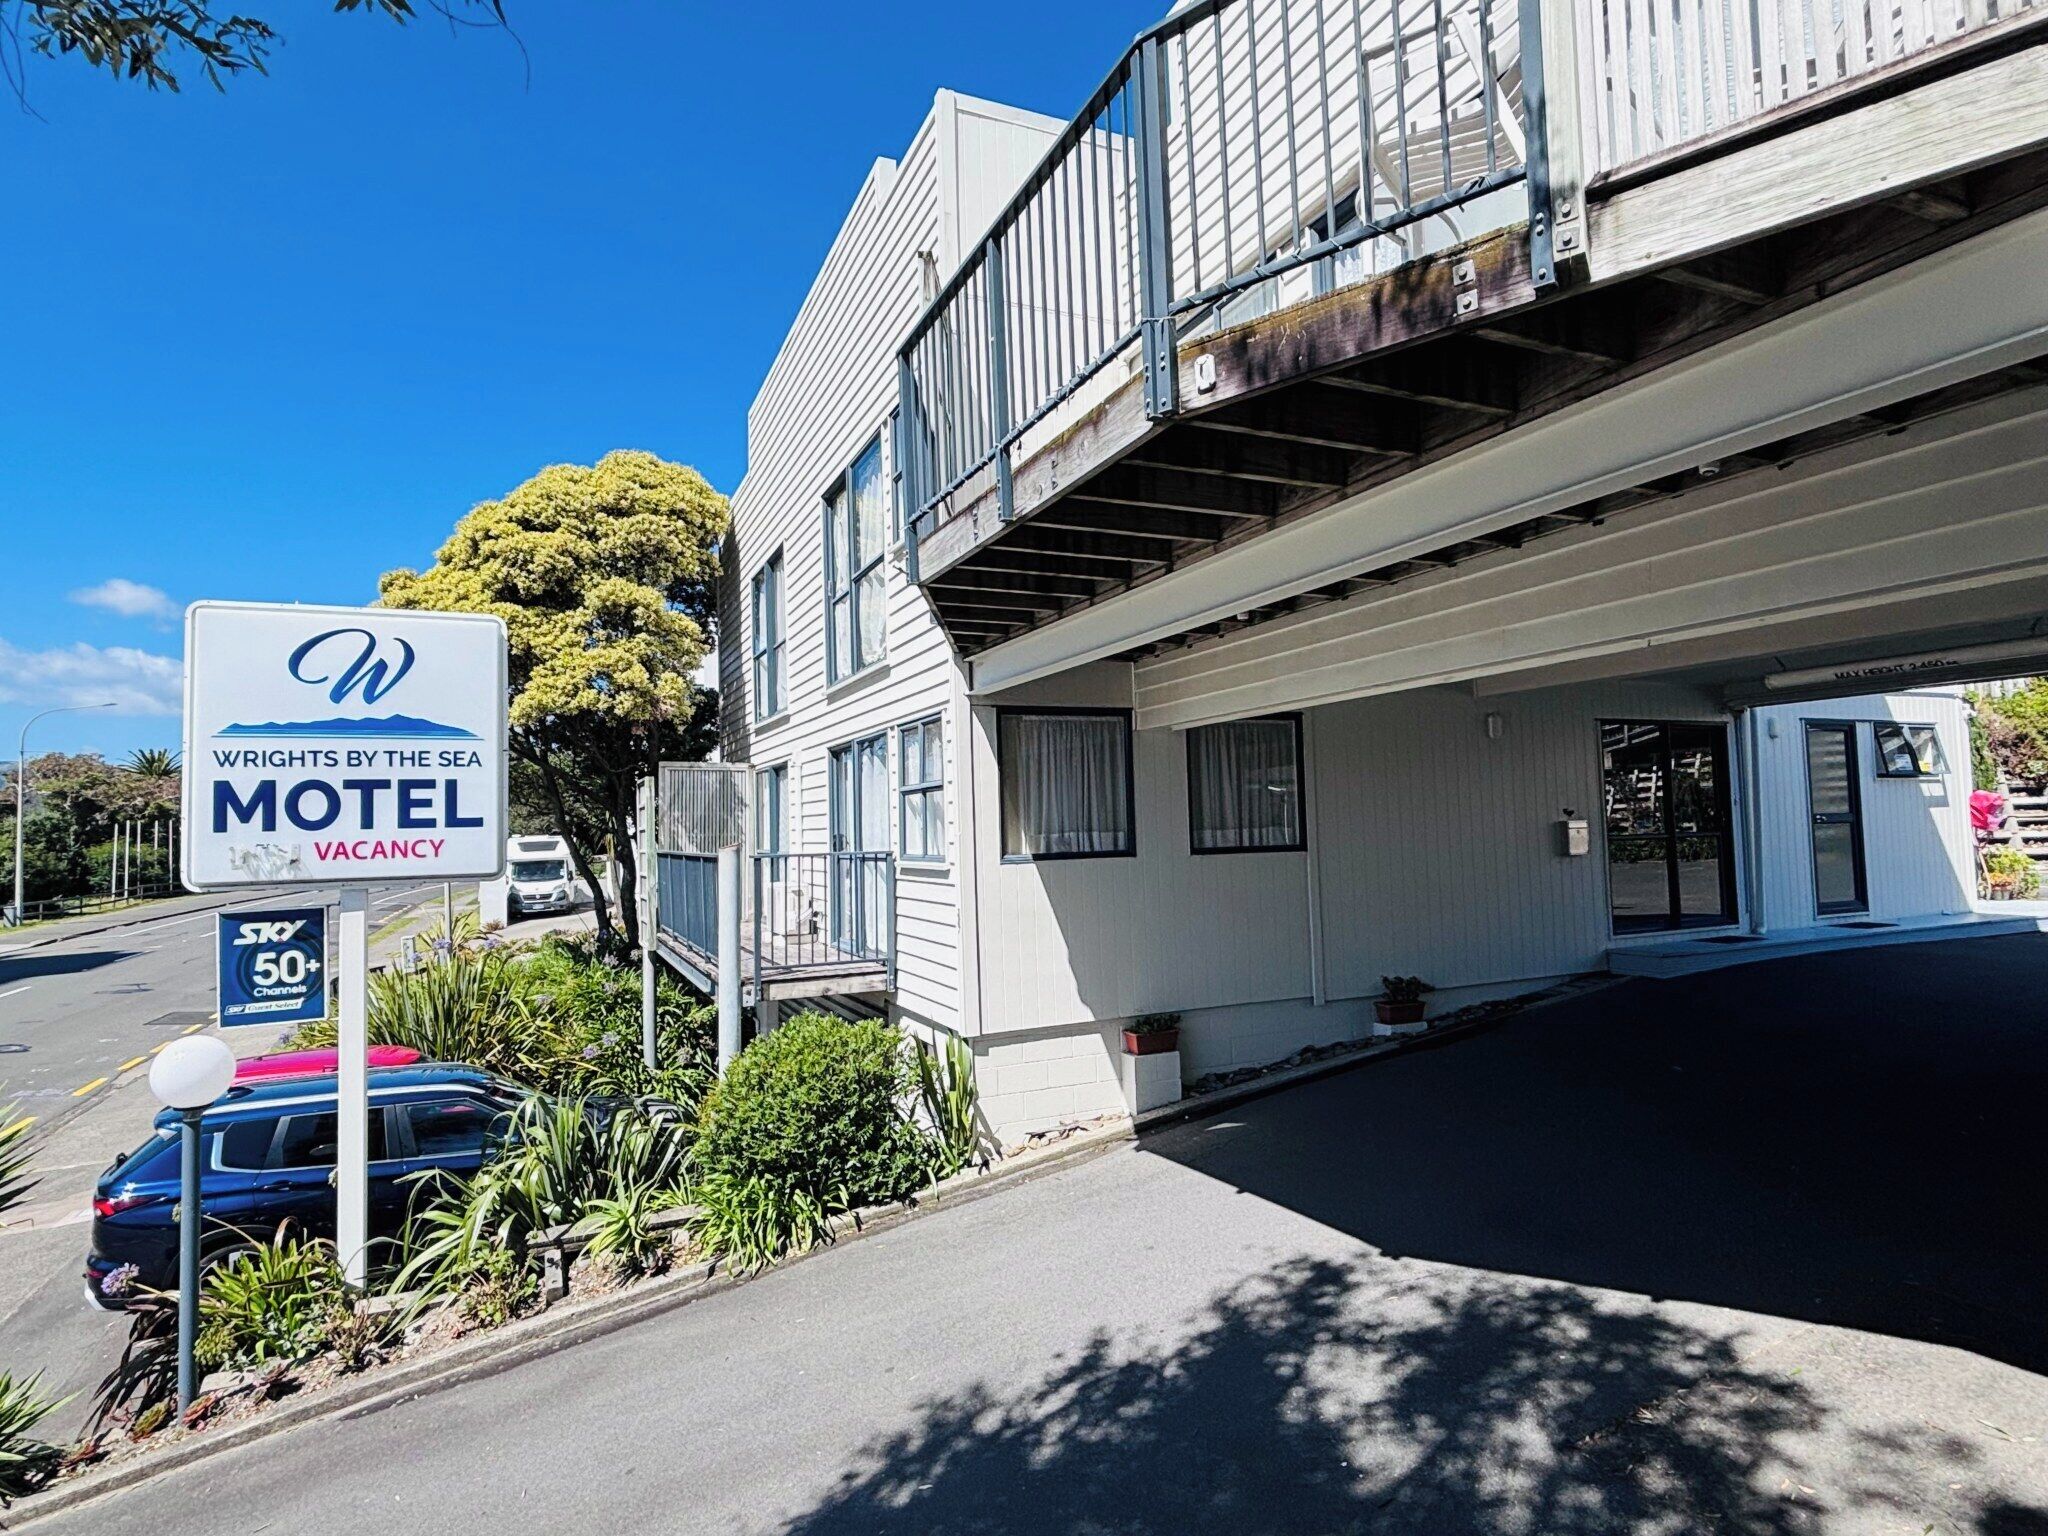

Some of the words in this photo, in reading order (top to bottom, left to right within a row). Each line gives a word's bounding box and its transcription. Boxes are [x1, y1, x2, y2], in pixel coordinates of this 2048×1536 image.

[213, 750, 339, 768] WRIGHTS
[347, 750, 382, 768] BY
[383, 750, 431, 768] THE
[438, 751, 483, 768] SEA
[212, 778, 484, 833] MOTEL
[314, 839, 445, 861] VACANCY
[233, 920, 307, 946] SKY
[252, 949, 321, 986] 50+
[253, 984, 307, 997] Channels
